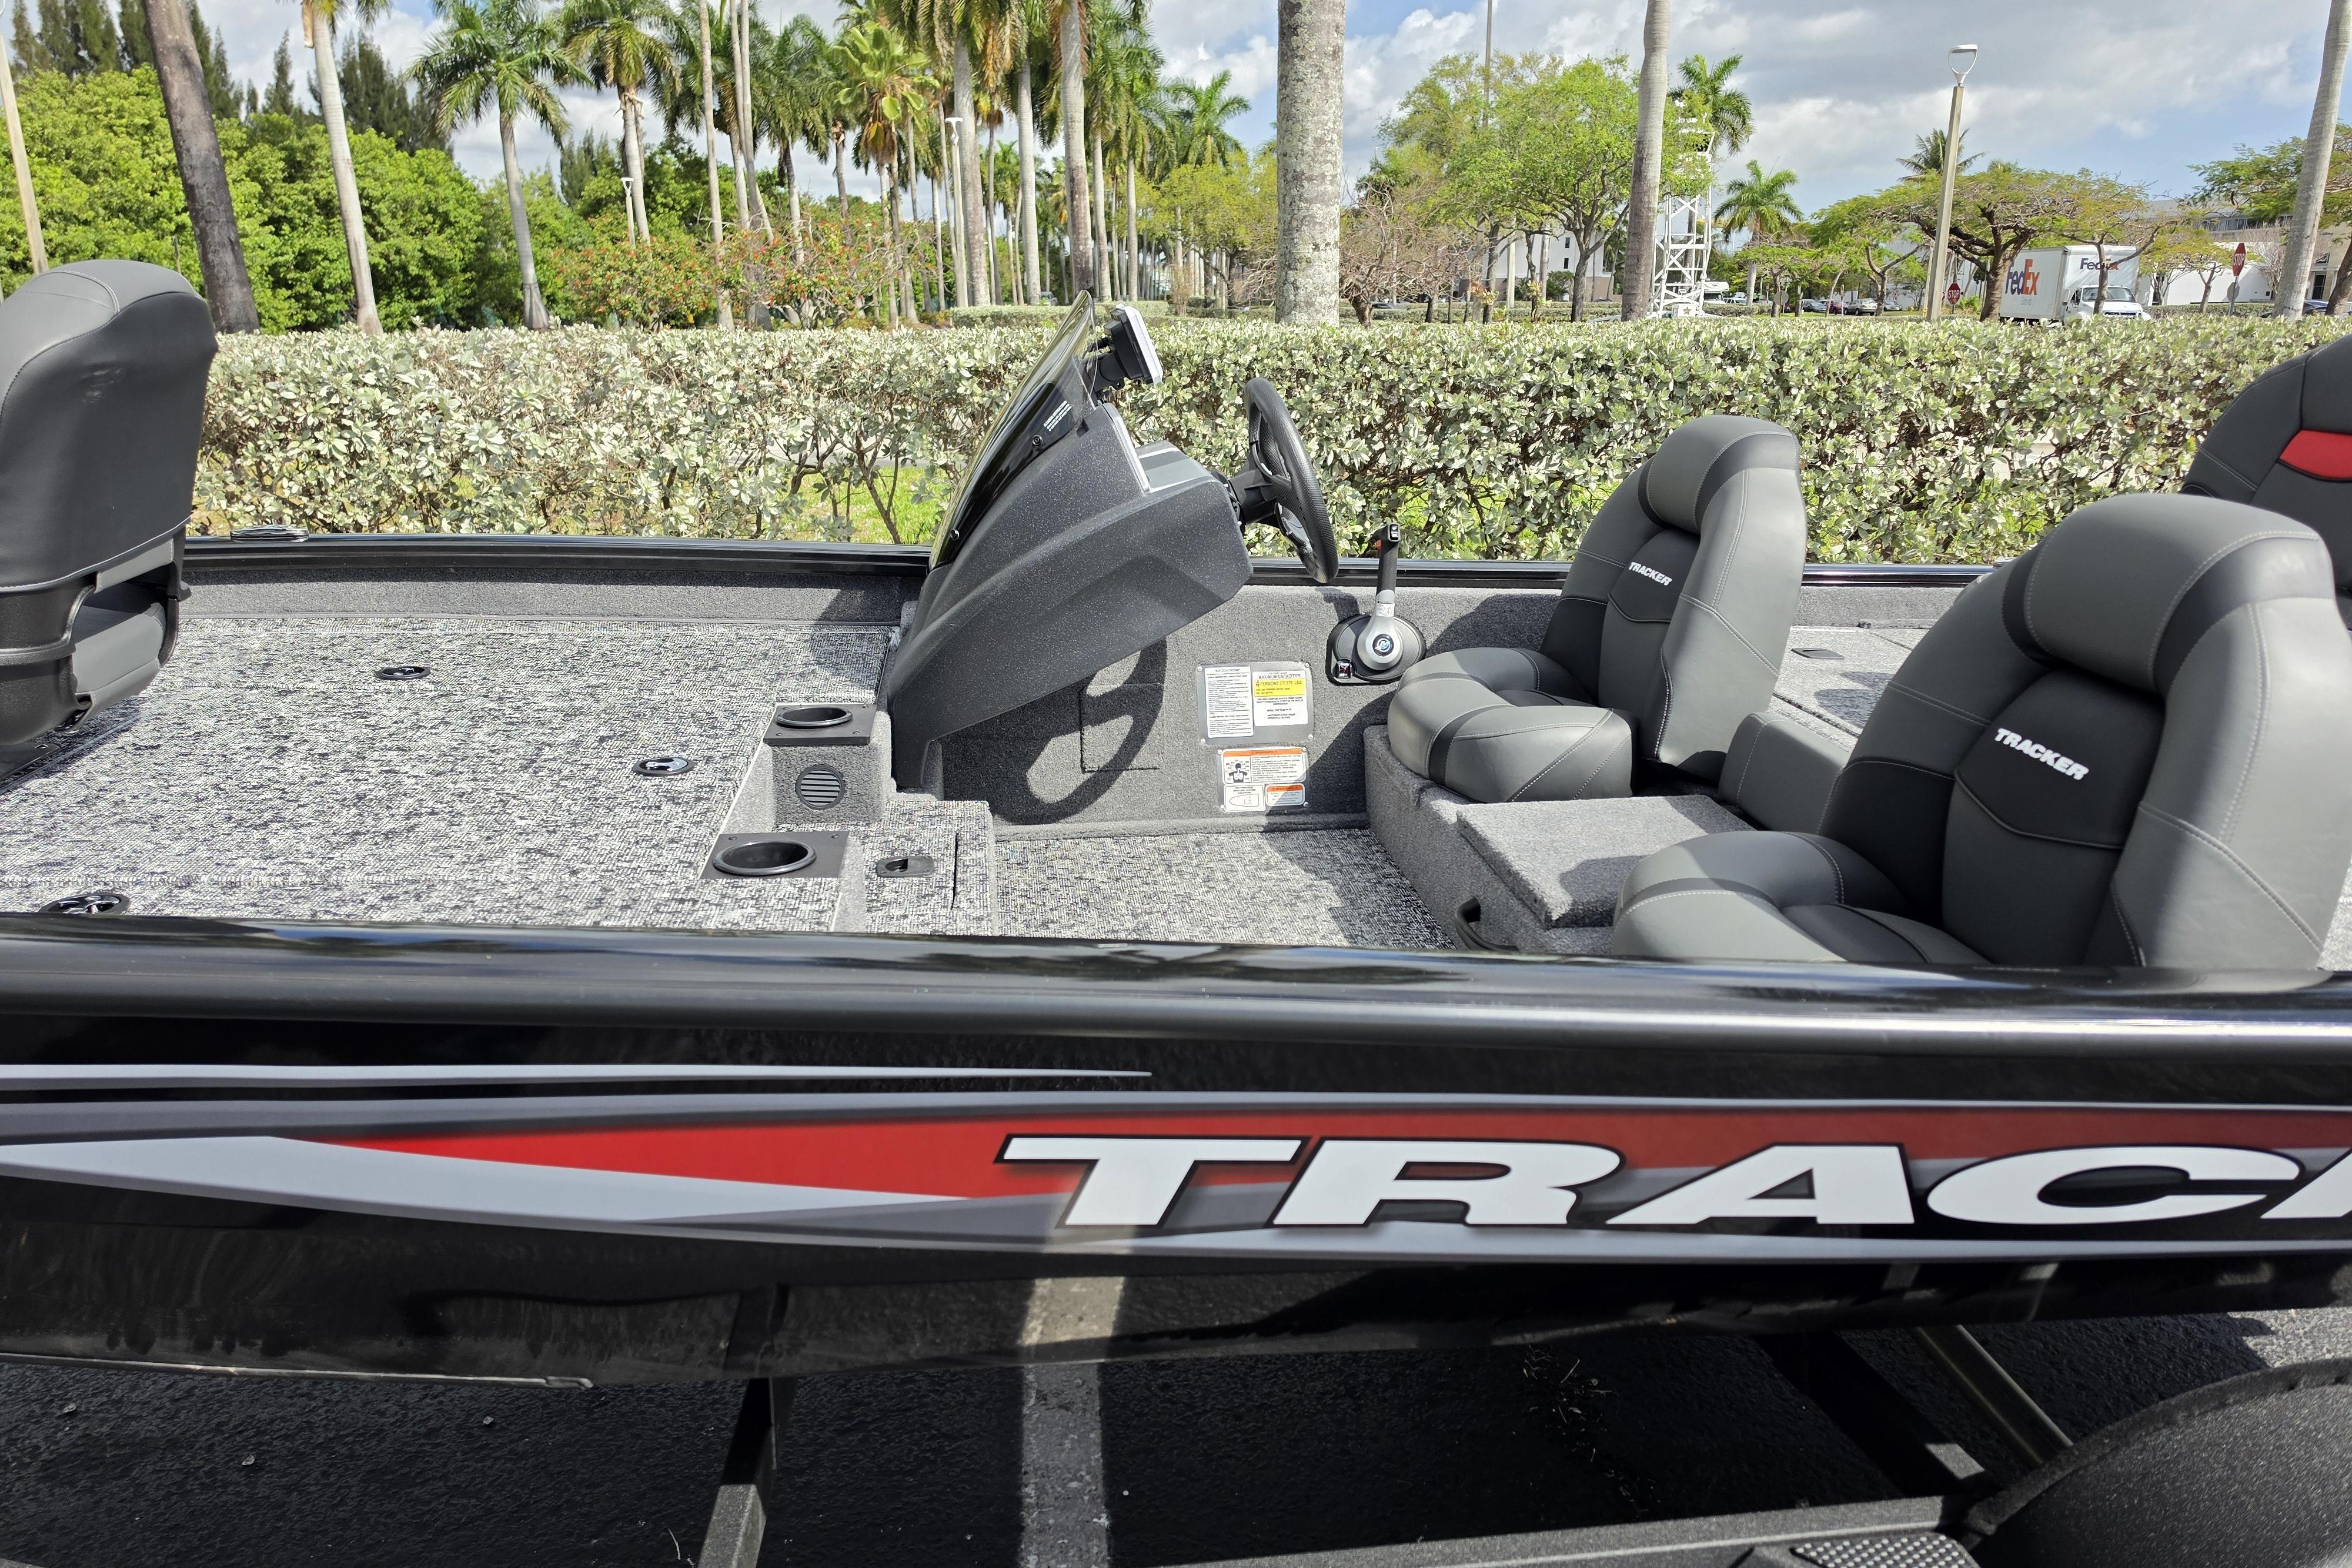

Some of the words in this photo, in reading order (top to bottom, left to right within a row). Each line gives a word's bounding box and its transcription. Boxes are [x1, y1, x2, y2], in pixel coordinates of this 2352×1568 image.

[2233, 253, 2245, 266] STOP
[1948, 290, 1960, 299] STOP
[1628, 561, 1672, 586] TRACKER
[1994, 728, 2089, 781] TRACKER
[1003, 1136, 2352, 1225] TRAC
